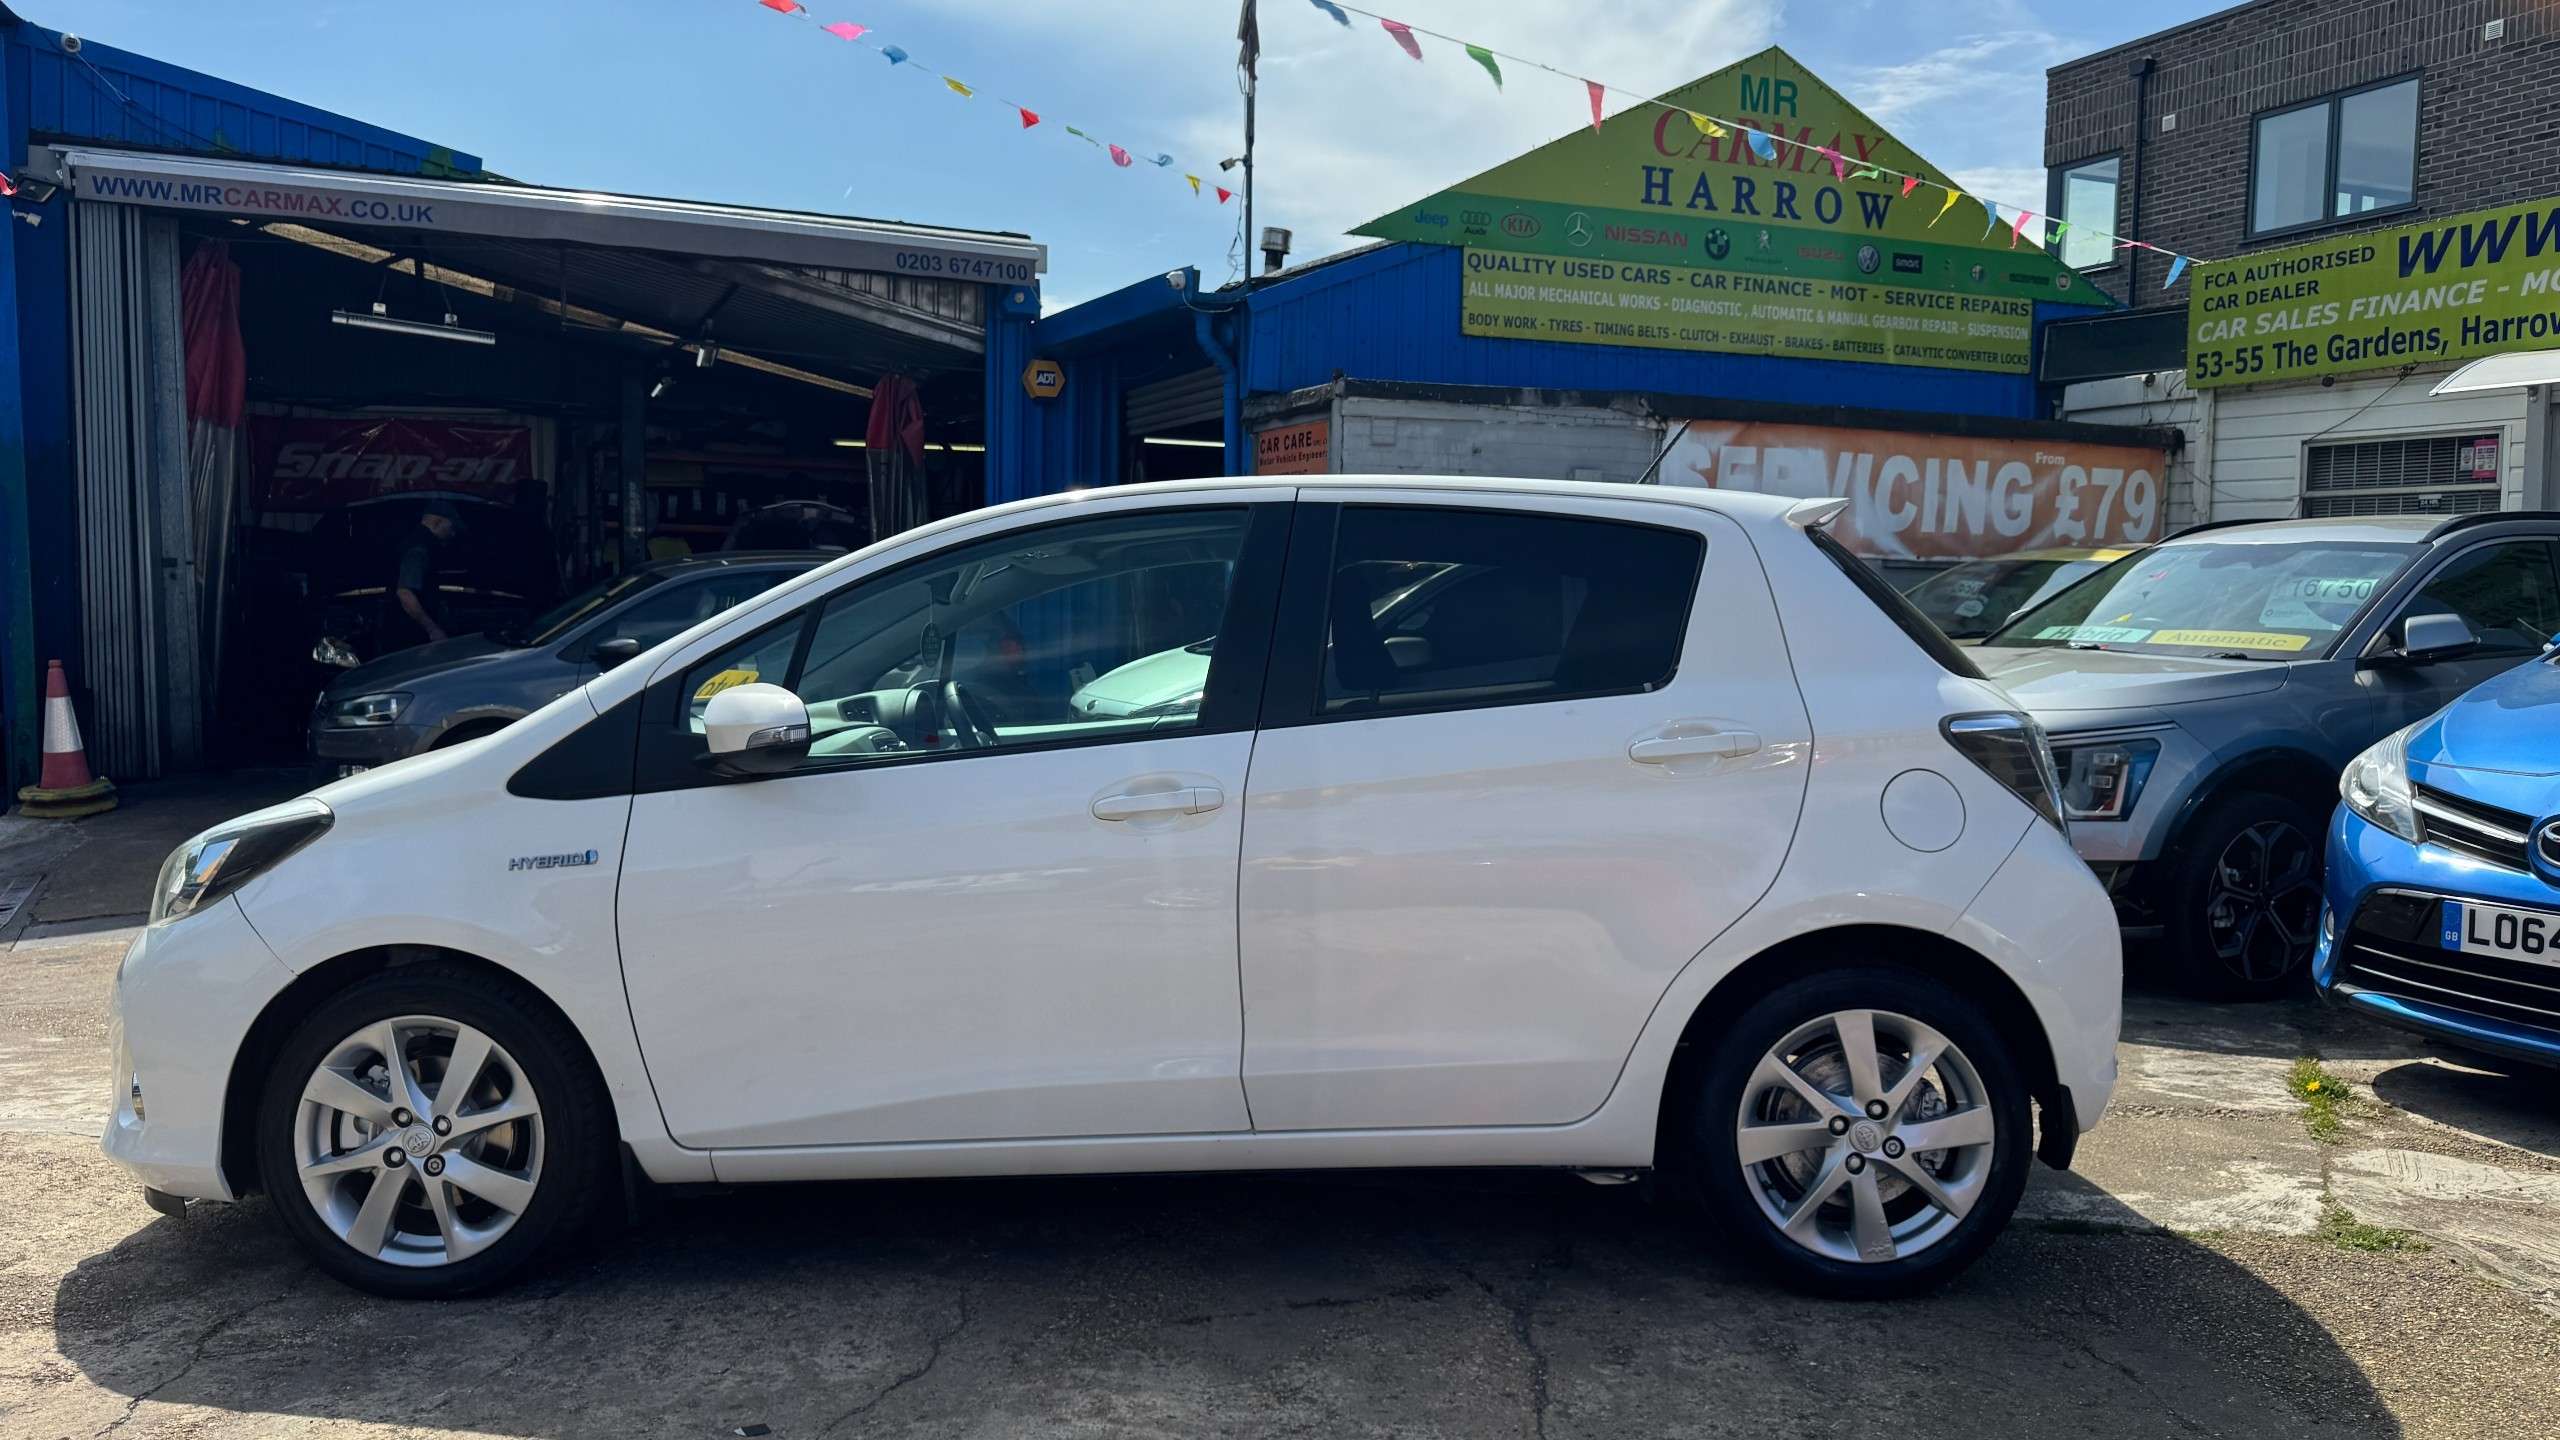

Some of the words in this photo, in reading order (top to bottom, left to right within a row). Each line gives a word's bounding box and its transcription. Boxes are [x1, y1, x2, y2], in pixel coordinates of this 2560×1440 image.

[1740, 73, 1798, 118] MR
[1653, 108, 1885, 181] CARMAX
[92, 175, 433, 223] WWW.MRCARMAX.CO.UK
[1641, 165, 1893, 230] HARROW
[1415, 209, 1449, 228] Jeep
[1507, 216, 1534, 233] KIA
[1604, 224, 1688, 248] NISSAN
[896, 251, 943, 272] 0203
[948, 257, 1028, 281] 6747100
[1467, 252, 1557, 275] QUALITY
[1563, 262, 1614, 280] USED
[1621, 266, 1671, 286] CARS
[1690, 272, 1727, 290] CAR
[1733, 276, 1813, 298] FINANCE
[1831, 285, 1868, 302] MOT
[1884, 290, 1955, 311] SERVICE
[1960, 298, 2030, 317] REPAIRS
[2204, 271, 2238, 290] FCA
[2244, 246, 2376, 283] AUTHORISED
[1468, 281, 1491, 297] ALL
[1495, 283, 1536, 301] MAJOR
[1538, 287, 1616, 308] MECHANICAL
[1618, 292, 1661, 310] WORKS
[1671, 298, 1742, 317] DIAGNOSTIC
[1750, 305, 1814, 323] AUTOMATIC
[1827, 311, 1870, 327] MANUAL
[1872, 315, 1919, 331] GEARBOX
[1921, 320, 1959, 335] REPAIR
[1967, 323, 2029, 340] SUSPENSION
[2197, 317, 2248, 344] CAR
[2254, 302, 2341, 335] SALES
[2347, 279, 2488, 322] FINANCE
[2203, 293, 2240, 312] CAR
[2246, 280, 2320, 306] DEALER
[1468, 313, 1500, 328] BODY
[1503, 314, 1537, 330] WORK
[1549, 319, 1583, 333] TYRES
[1594, 322, 1634, 337] TIMING
[1637, 325, 1670, 339] BELTS
[1679, 328, 1720, 343] CLUTCH
[1729, 332, 1776, 347] EXHAUST
[1784, 336, 1824, 351] BRAKES
[1832, 339, 1885, 354] BATTERIES
[1892, 344, 1945, 359] CATALYTIC
[1945, 348, 2000, 364] CONVERTER
[2000, 353, 2029, 366] LOCKS
[2195, 345, 2264, 380] 53-55
[2272, 340, 2319, 370] The
[2327, 326, 2449, 364] Gardens,
[1036, 371, 1057, 385] ADT
[1260, 437, 1280, 454] CAR
[1283, 431, 1312, 450] CARE
[2035, 451, 2066, 467] From
[273, 442, 518, 489] Snap-on
[2054, 464, 2157, 541] £79
[2050, 626, 2133, 641] Hybrid
[2166, 631, 2288, 648] Automatic
[508, 852, 585, 872] HYBRID
[2444, 930, 2459, 942] GB
